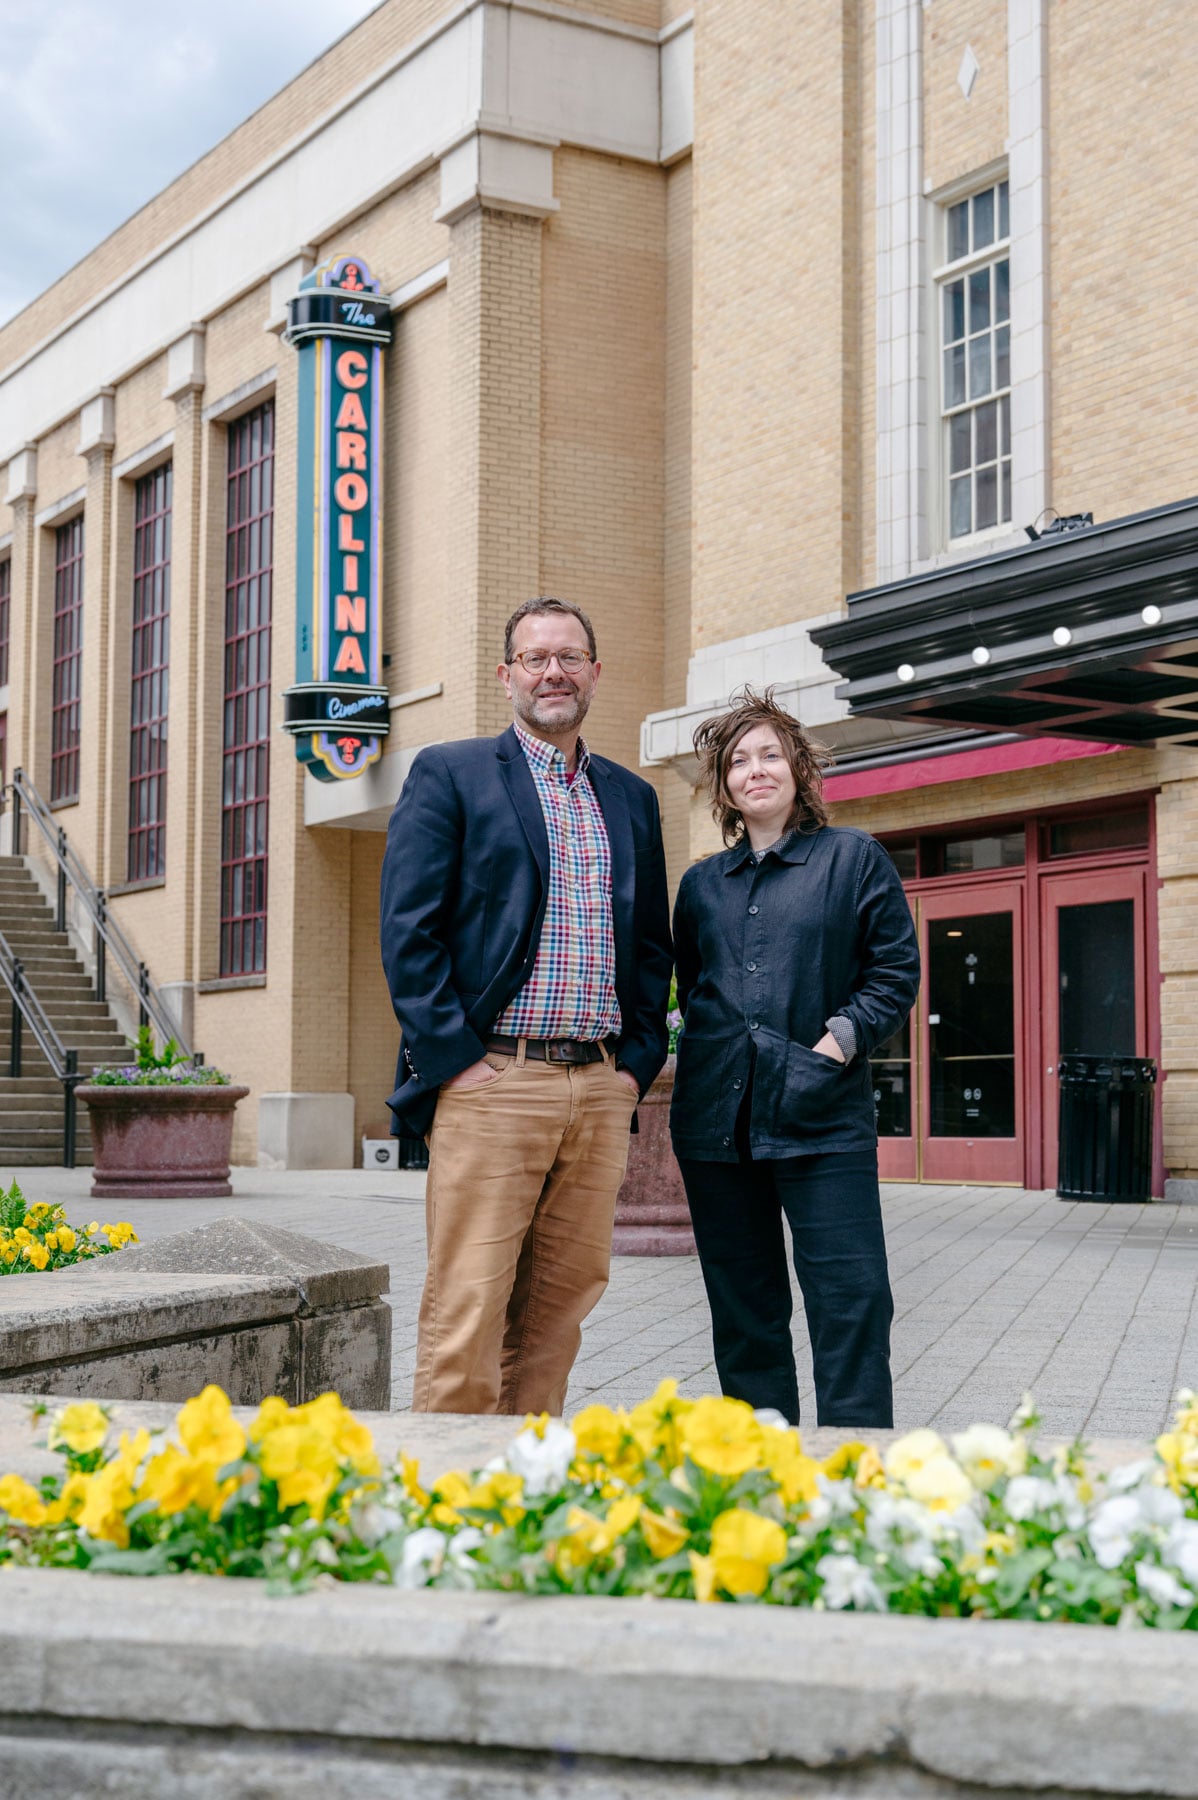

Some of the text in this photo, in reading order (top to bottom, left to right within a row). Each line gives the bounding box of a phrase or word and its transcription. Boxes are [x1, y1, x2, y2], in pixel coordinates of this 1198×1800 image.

[341, 302, 376, 326] The
[334, 350, 368, 674] CAROLINA
[328, 696, 386, 719] Cinemas
